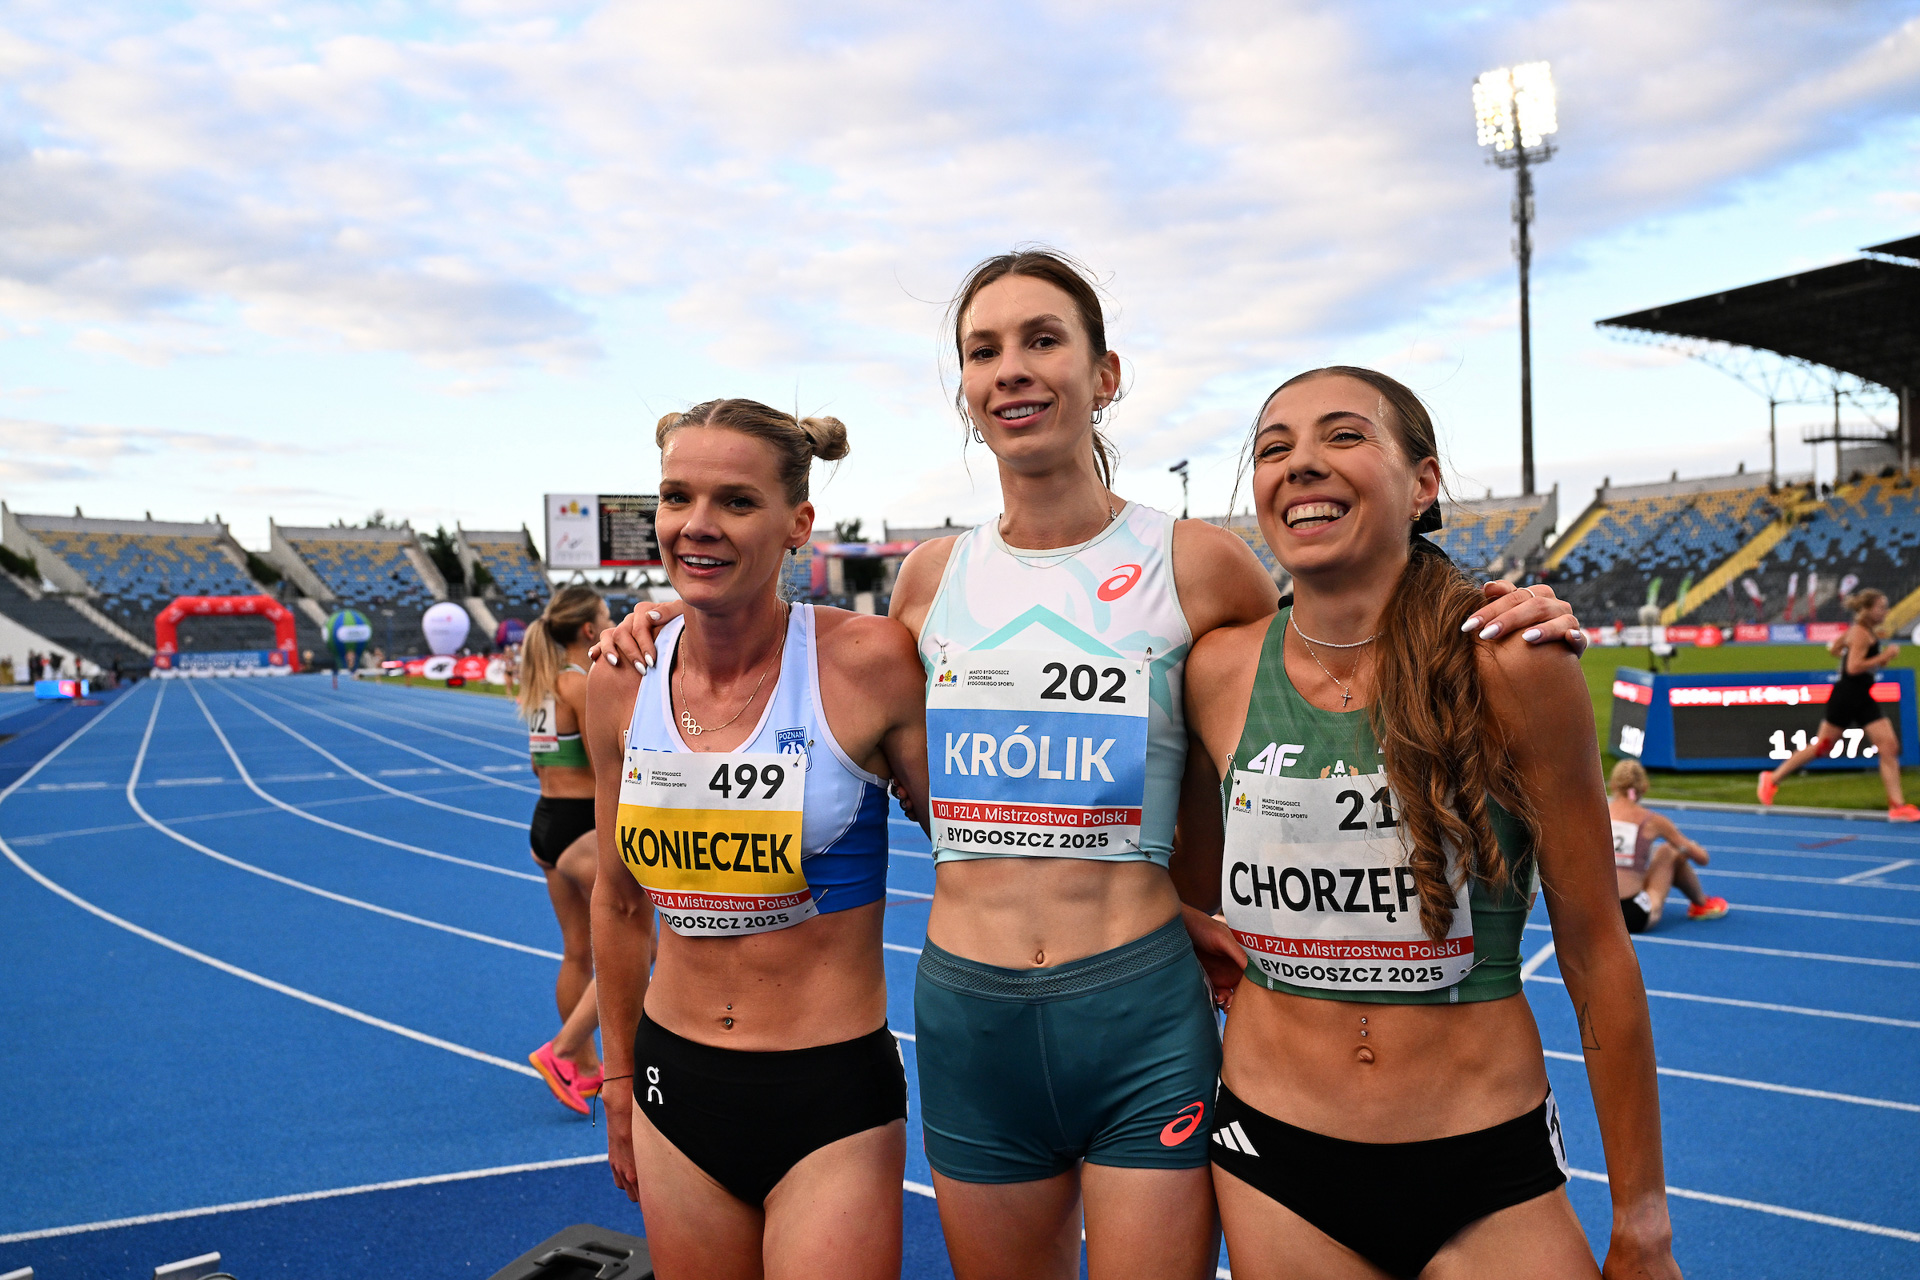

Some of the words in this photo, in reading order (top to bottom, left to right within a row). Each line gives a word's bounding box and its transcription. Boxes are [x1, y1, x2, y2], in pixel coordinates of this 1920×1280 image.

[1040, 662, 1127, 704] 202
[944, 724, 1117, 783] KRÓLIK
[1248, 742, 1305, 777] 4F
[709, 763, 786, 800] 499
[937, 803, 952, 818] 101.
[953, 806, 981, 820] PZLA
[985, 806, 1078, 825] Mistrzostwa
[1082, 810, 1128, 825] Polski
[1335, 786, 1402, 831] 21
[620, 825, 795, 875] KONIECZEK
[947, 827, 1055, 848] BYDGOSZCZ
[1059, 832, 1109, 849] 2025
[650, 892, 675, 907] PZLA
[677, 895, 755, 910] Mistrzostwa
[758, 894, 801, 909] Polski
[1229, 861, 1459, 923] CHORZĘP
[660, 911, 741, 930] DGOSZCZ
[743, 913, 789, 928] 2025
[1240, 933, 1264, 950] 101.
[1265, 939, 1299, 956] PZLA
[1303, 941, 1404, 958] Mistrzostwa
[1408, 940, 1461, 958] Polski
[1259, 957, 1383, 984] BYDGOSZCZ
[1388, 966, 1445, 983] 2025
